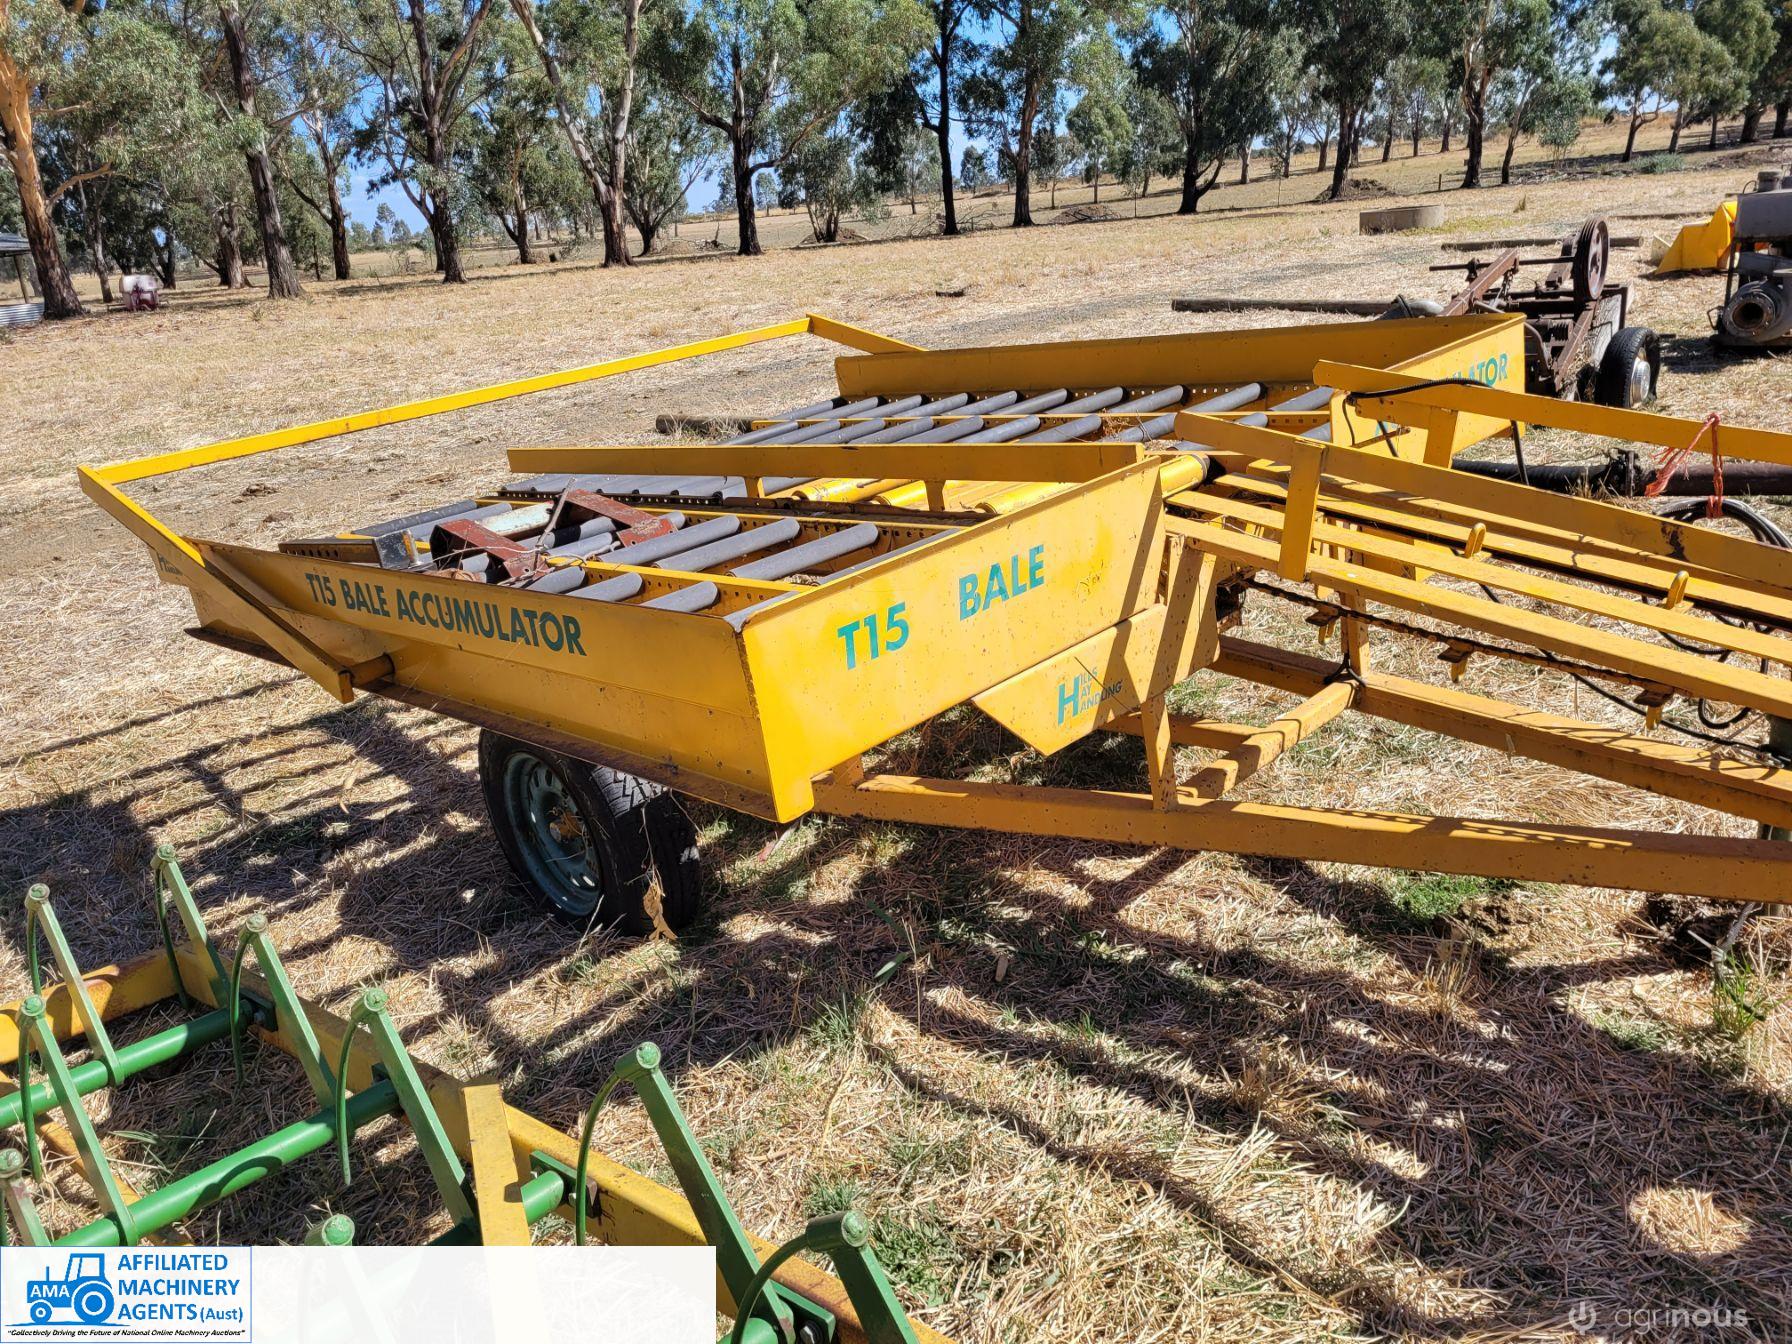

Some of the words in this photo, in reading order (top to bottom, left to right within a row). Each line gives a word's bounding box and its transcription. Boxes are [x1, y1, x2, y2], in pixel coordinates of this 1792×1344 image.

[305, 572, 337, 607] T15
[340, 578, 391, 618] BALE
[397, 588, 587, 657] ACCUMULATOR
[837, 602, 910, 670] T15
[958, 544, 1045, 621] BALE
